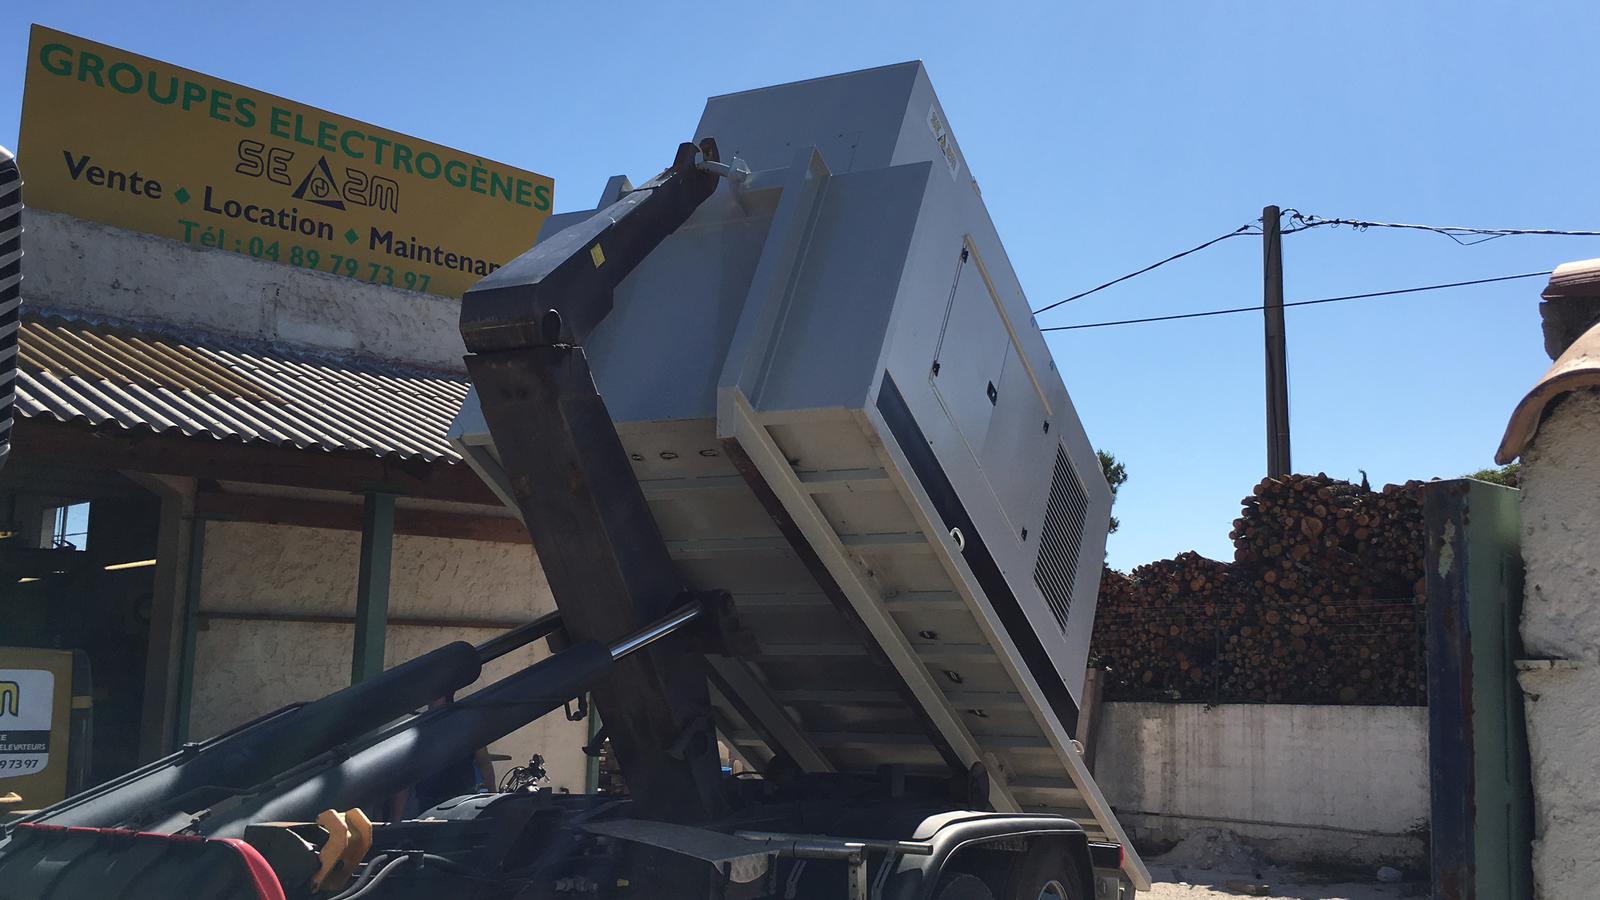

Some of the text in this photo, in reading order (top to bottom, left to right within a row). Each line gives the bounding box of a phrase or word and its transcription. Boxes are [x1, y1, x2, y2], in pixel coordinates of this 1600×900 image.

[40, 43, 550, 211] GROUPES ELECTROGÈNES
[63, 150, 162, 199] Vente
[203, 186, 334, 241] Location
[249, 236, 280, 262] 04
[289, 245, 320, 269] 89
[330, 254, 358, 278] 79
[367, 262, 395, 286] 73
[403, 271, 431, 292] 97
[24, 759, 38, 769] 97
